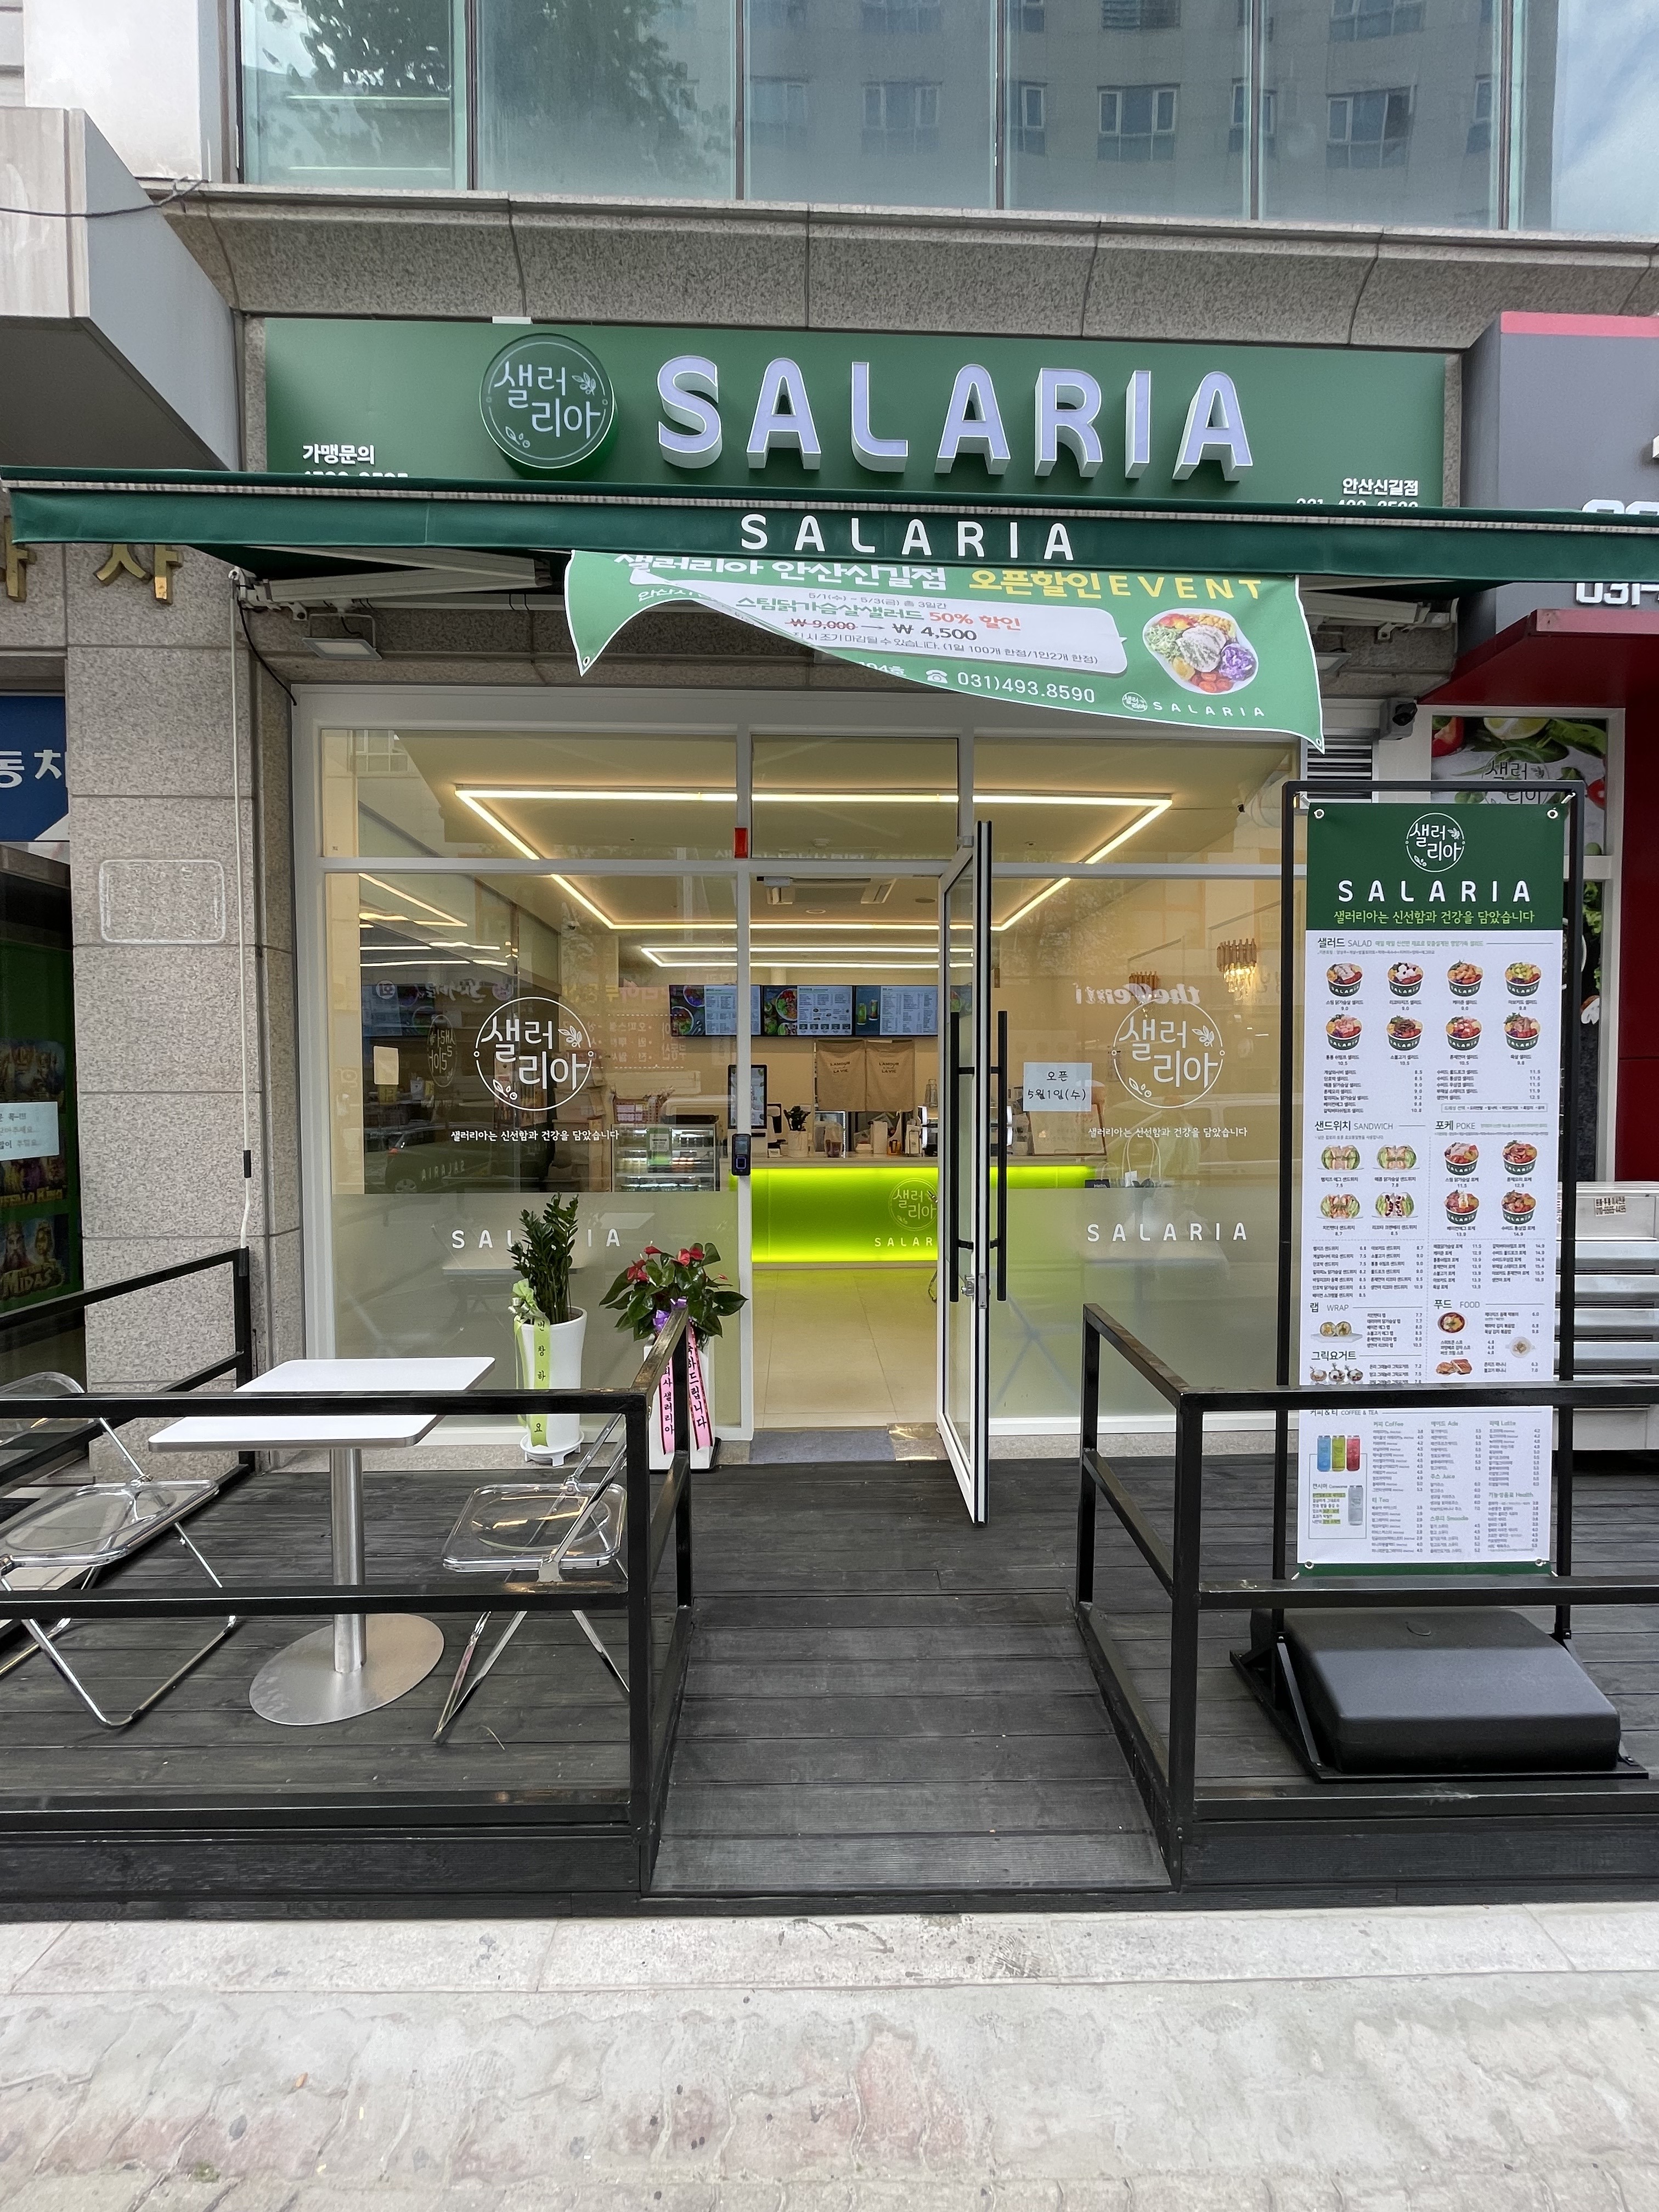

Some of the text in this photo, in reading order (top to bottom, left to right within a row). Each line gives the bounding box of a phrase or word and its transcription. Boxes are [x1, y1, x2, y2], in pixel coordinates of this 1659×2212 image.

[494, 361, 566, 409] 샐러
[531, 398, 601, 438] 리아
[657, 355, 1253, 481] SALARIA
[302, 443, 375, 466] 가맹문의
[1342, 478, 1419, 496] 안산신길점
[741, 514, 1075, 561] SALARIA
[614, 554, 764, 574] 샐러리아
[771, 561, 946, 590] 안산신길점
[1109, 575, 1261, 599] EVENT
[736, 597, 1022, 631] 스팀닭가슴살샐러드 50% 할인
[921, 626, 977, 641] 4,500
[969, 646, 1001, 656] 100개
[957, 672, 1095, 703] 031)493.8590
[1153, 701, 1265, 716] SALARIA
[1409, 823, 1446, 848] 샐러
[1427, 842, 1462, 862] 리아
[1338, 879, 1531, 903] SALARIA
[1334, 910, 1535, 925] 샐러리아는 신선함과 건강을 담았습니다
[1317, 937, 1345, 948] 샐러드
[481, 1018, 553, 1061] 샐러
[1119, 1015, 1187, 1061] 샐러
[518, 1051, 586, 1090] 리아
[1046, 1071, 1068, 1081] 오픈
[1153, 1051, 1218, 1088] 리아
[1088, 1127, 1248, 1138] 샐러리아는 신선함과 건강을 담았습니다
[1314, 1120, 1351, 1131] 샌드위치
[1435, 1120, 1454, 1131] 포케
[450, 1130, 619, 1142] 샐러리아는 신선함과 건강을 담았습니다
[893, 1188, 923, 1208] 샐러
[908, 1204, 936, 1220] 리아
[452, 1229, 620, 1249] SALIA
[1087, 1222, 1248, 1242] SALARIA
[1310, 1302, 1319, 1313] 랩
[1434, 1299, 1452, 1310] 푸드
[1311, 1351, 1357, 1361] 그릭요거트
